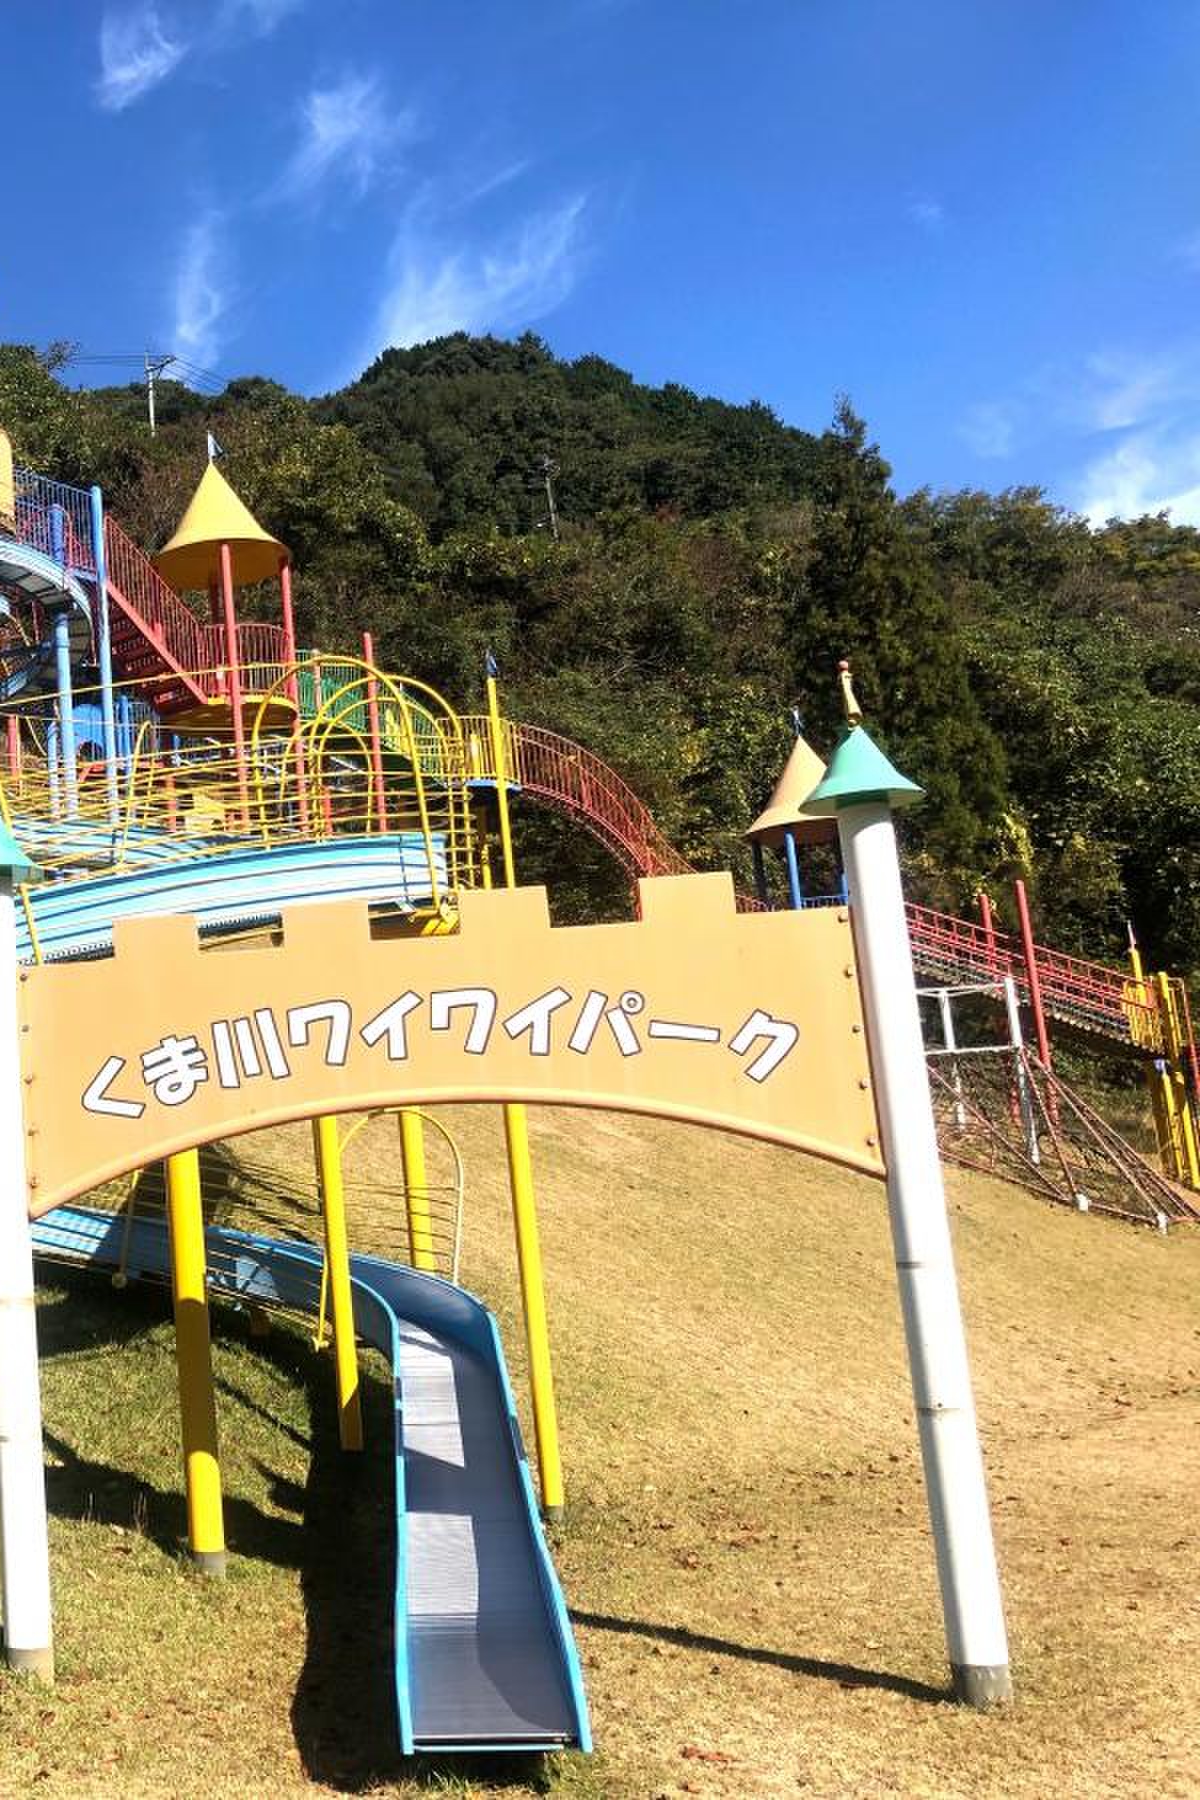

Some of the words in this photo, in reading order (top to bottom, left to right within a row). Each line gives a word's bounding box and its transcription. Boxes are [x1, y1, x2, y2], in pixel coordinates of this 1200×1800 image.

[81, 987, 800, 1119] くま川ワイワイパーク
